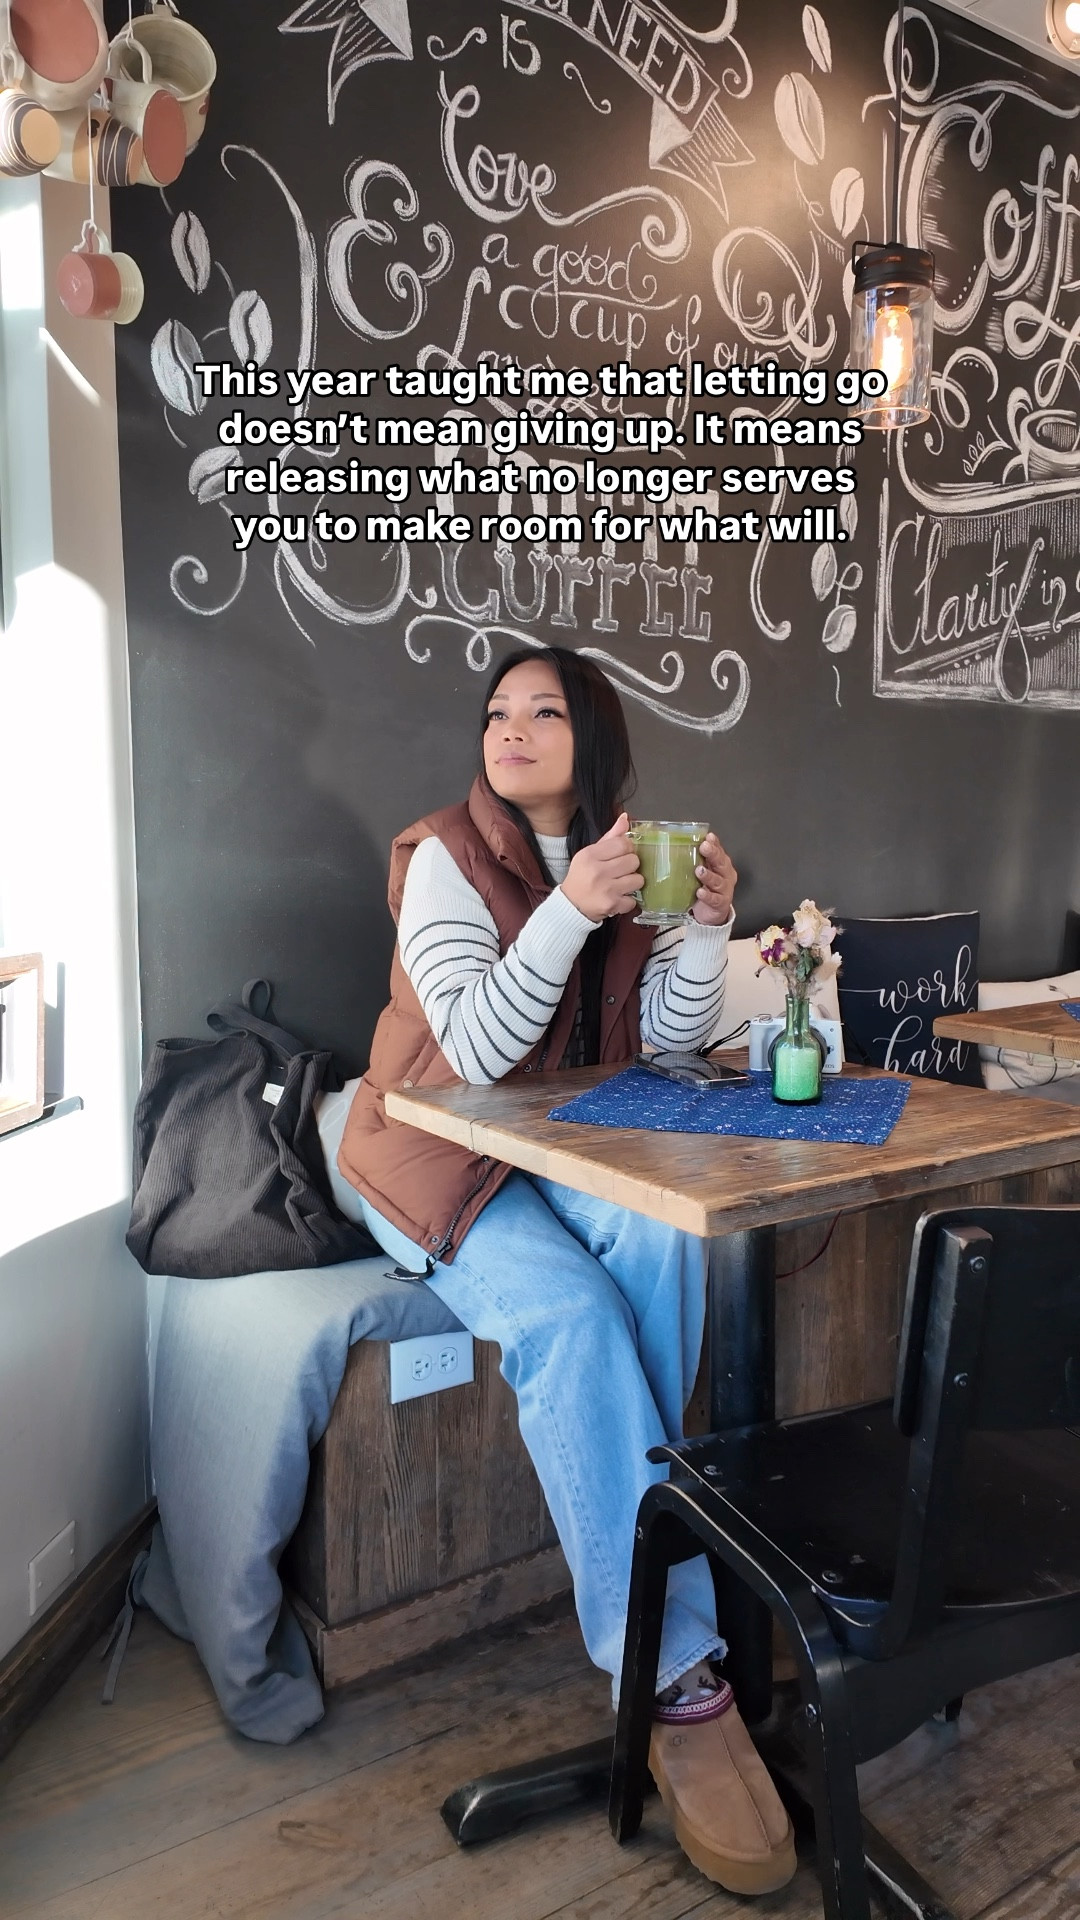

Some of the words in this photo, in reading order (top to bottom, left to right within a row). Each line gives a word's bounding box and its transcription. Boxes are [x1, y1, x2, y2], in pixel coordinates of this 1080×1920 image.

[501, 13, 542, 76] IS
[583, 0, 700, 114] NEED
[437, 70, 615, 227] Love
[481, 233, 520, 269] a
[530, 242, 658, 339] good
[569, 298, 647, 366] cup
[665, 294, 702, 432] of
[886, 512, 1045, 701] Clarity
[838, 944, 979, 1015] work
[872, 1007, 977, 1074] hard
